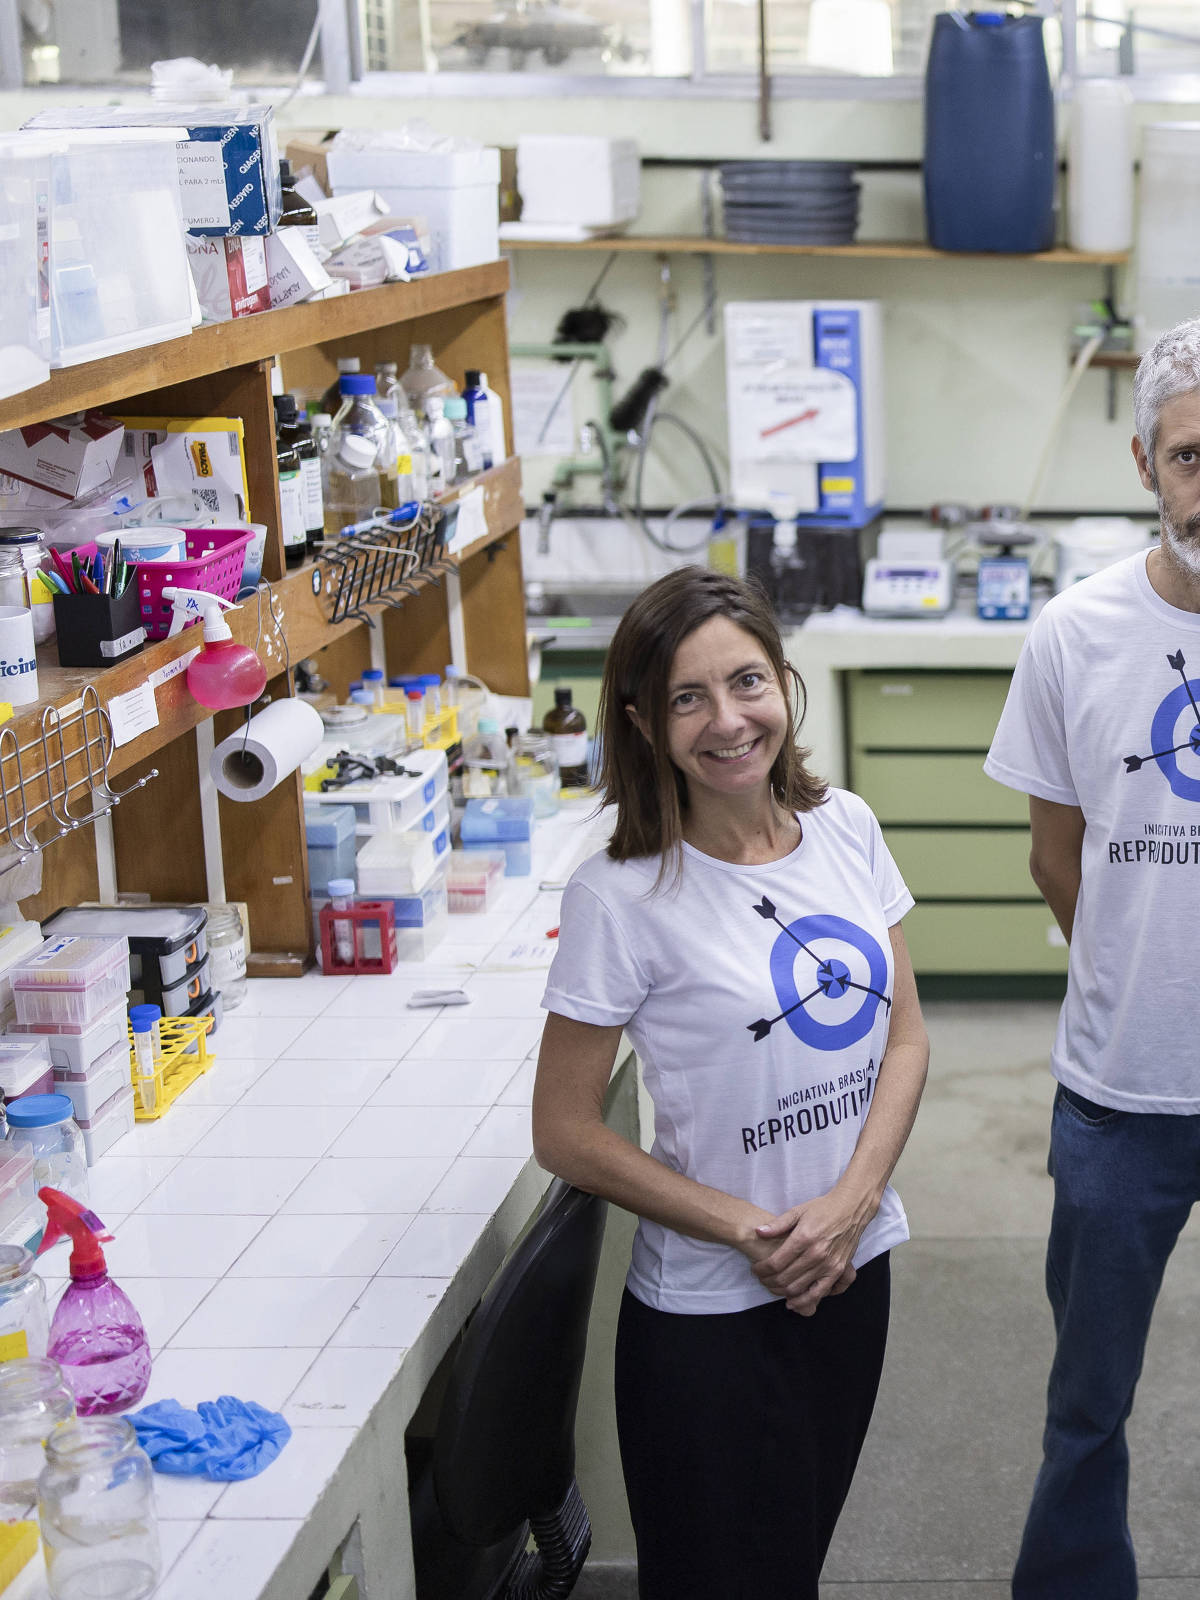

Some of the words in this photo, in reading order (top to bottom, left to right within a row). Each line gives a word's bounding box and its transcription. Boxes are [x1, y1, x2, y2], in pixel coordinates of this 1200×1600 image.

[220, 125, 239, 148] AGEN
[228, 183, 255, 211] QIAGEN
[777, 1080, 836, 1112] INICIATIVA
